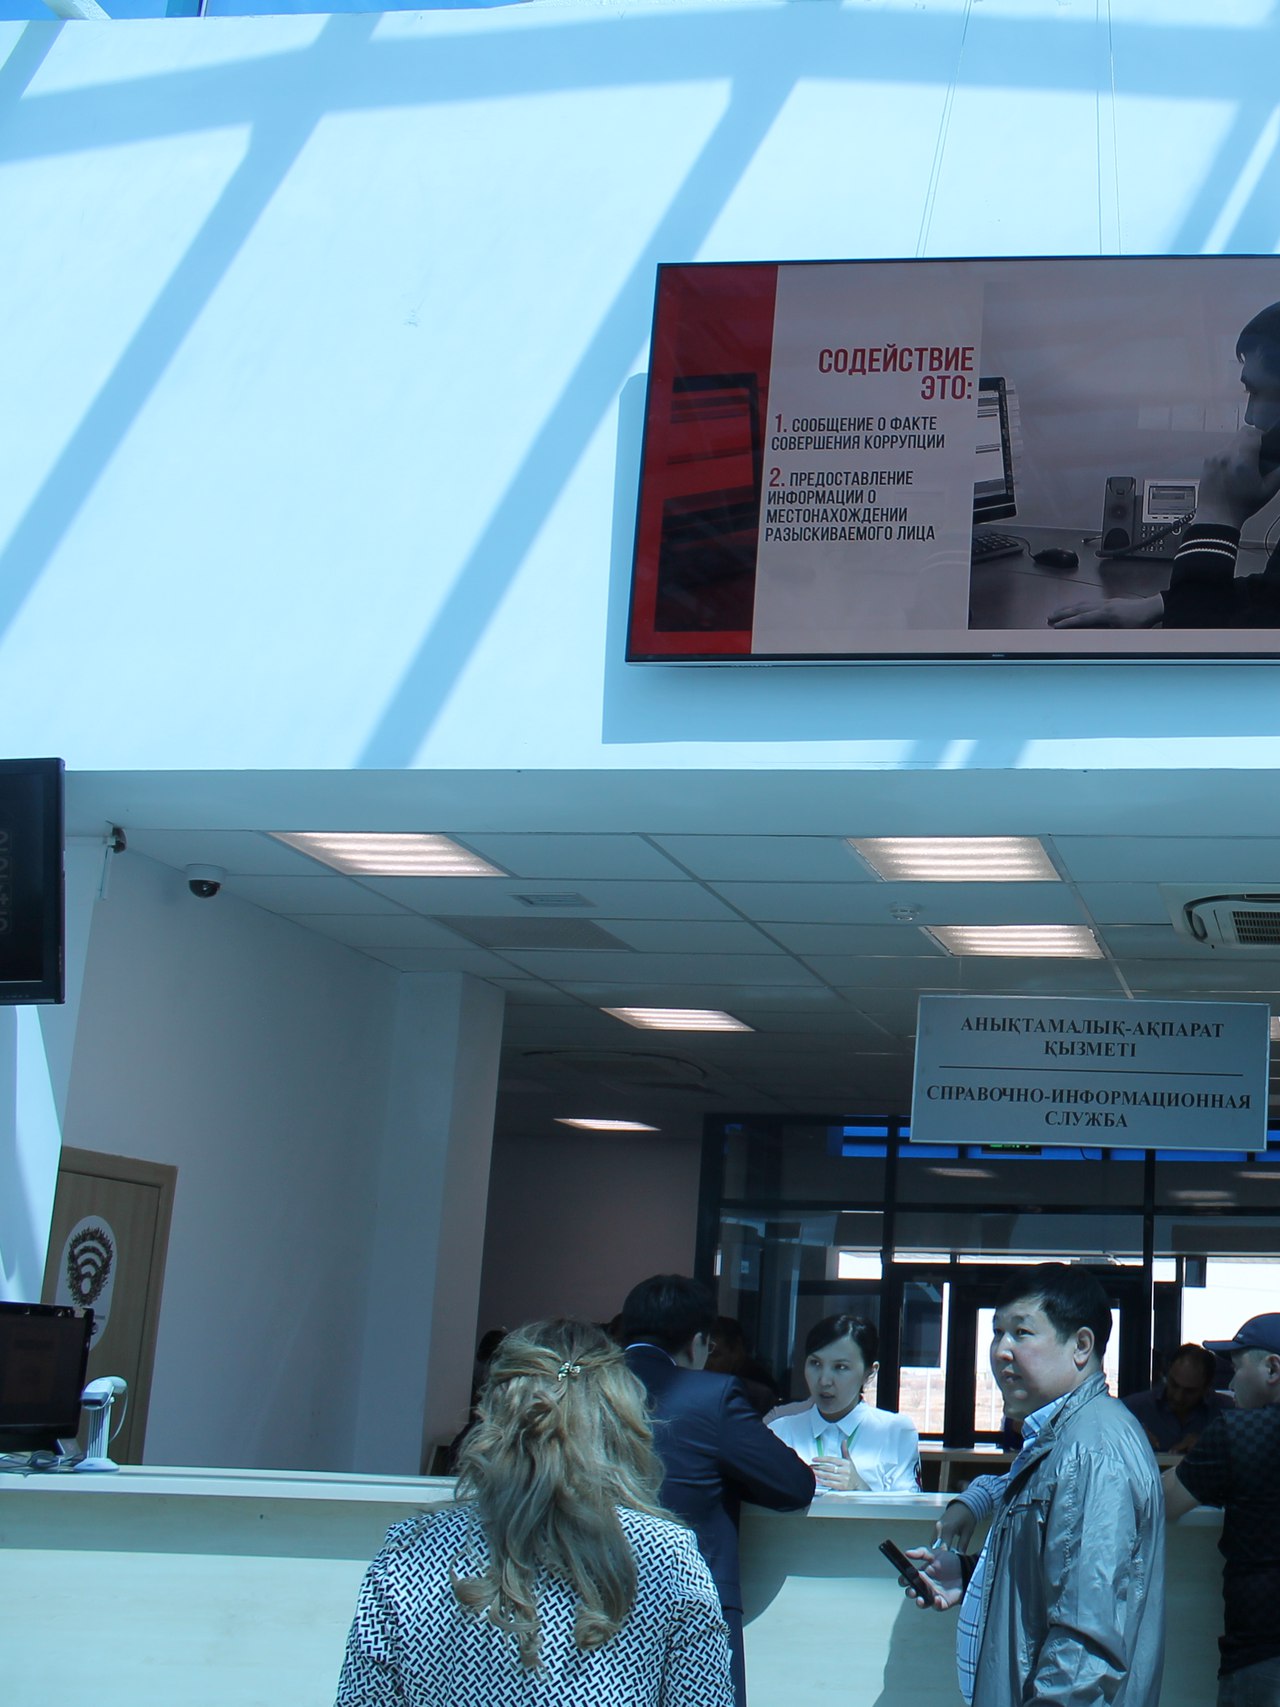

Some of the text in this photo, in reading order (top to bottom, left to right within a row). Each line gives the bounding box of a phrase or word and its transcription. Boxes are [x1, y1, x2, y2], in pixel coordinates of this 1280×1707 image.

[818, 343, 975, 376] СОДЕЙСТВИЕ
[920, 375, 973, 400] ЭТО:
[775, 413, 938, 433] 1. СООБЩЕНИЕ О ФАКТЕ
[771, 434, 945, 451] СОВЕРШЕНИЯ КОРРУПЦИИ
[768, 467, 914, 487] 2. ПРЕДОСТАВЛЕНИЕ
[767, 489, 876, 505] ИНФОРМАЦИИ О
[766, 507, 908, 524] МЕСТОНАХОЖДЕНИИ
[765, 525, 936, 542] РАЗЫСКИВАЕМОГО ЛИЦА
[960, 1016, 1224, 1038] АНЫҚТАМАЛЫҚ-АҚПАРАТ
[1044, 1041, 1137, 1058] ҚЫЗМЕТІ
[926, 1085, 1251, 1110] СПРАВОЧНО-ИНФОРМАЦИОННАЯ
[1044, 1110, 1128, 1128] СЛУЖБА
